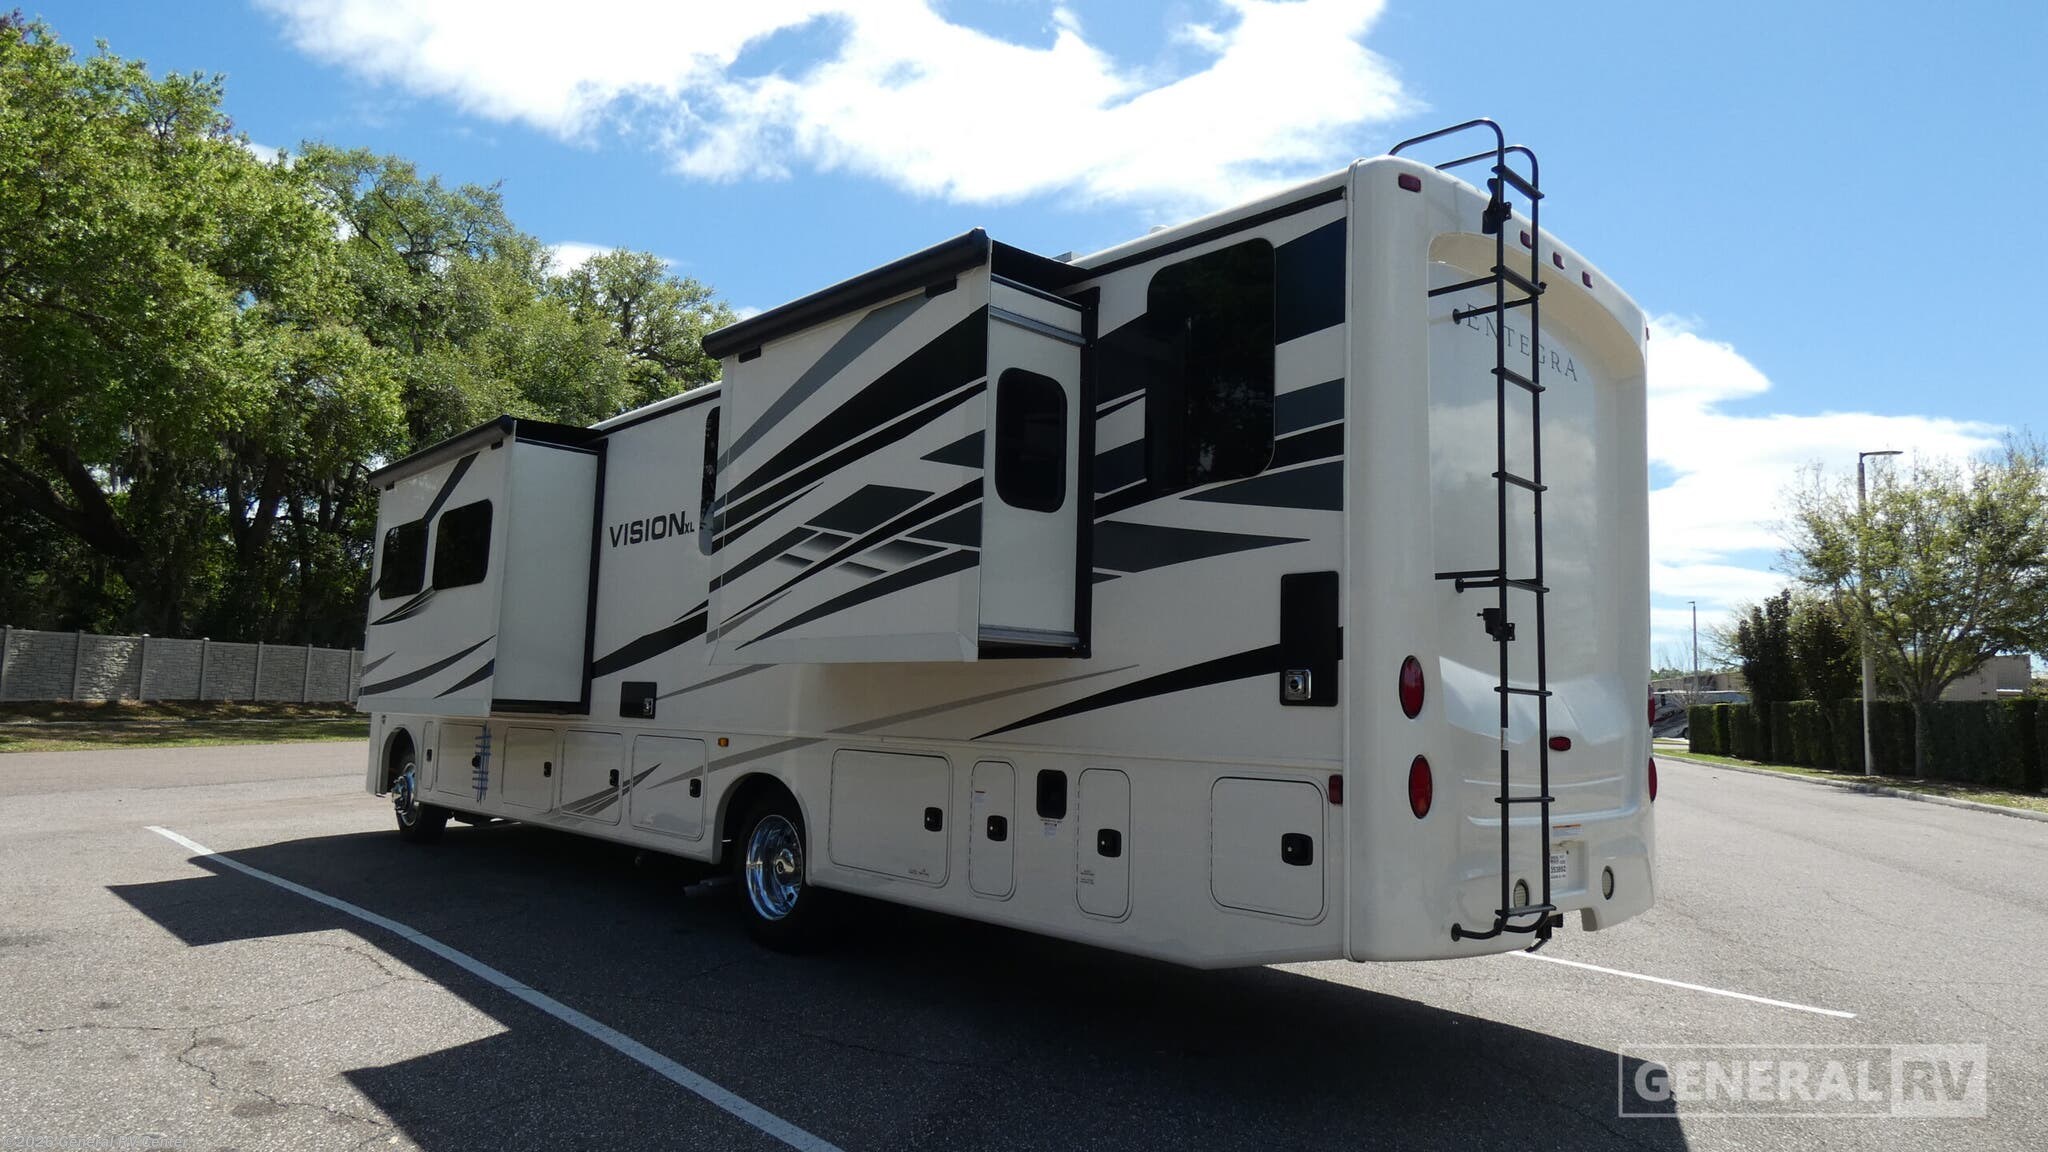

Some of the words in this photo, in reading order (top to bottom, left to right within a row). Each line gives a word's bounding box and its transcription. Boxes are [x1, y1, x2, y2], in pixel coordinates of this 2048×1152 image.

[1466, 303, 1578, 382] ENTEGRA
[609, 511, 686, 548] VISION
[684, 521, 695, 535] XL
